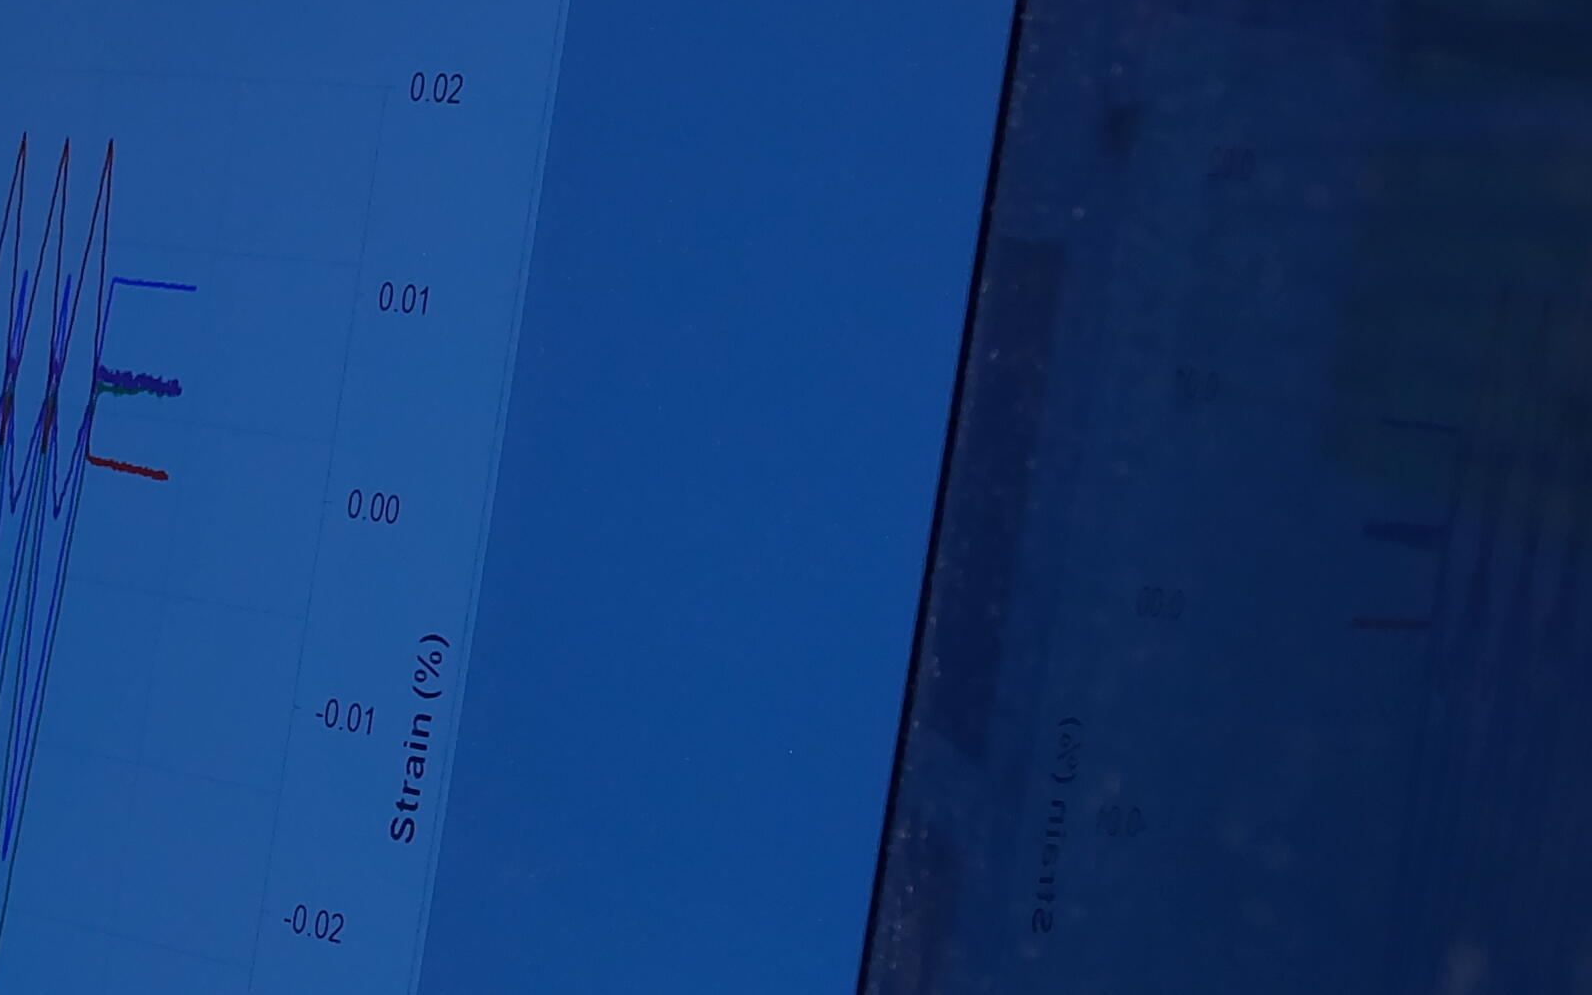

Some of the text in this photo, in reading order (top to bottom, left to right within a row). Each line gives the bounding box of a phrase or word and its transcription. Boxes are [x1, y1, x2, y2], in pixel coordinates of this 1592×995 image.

[410, 71, 464, 105] 0.02
[379, 281, 430, 315] 0.01
[347, 489, 400, 524] 0.00
[315, 698, 374, 736] -0.01
[390, 634, 450, 843] Strain (%)
[283, 904, 345, 944] -0.02
